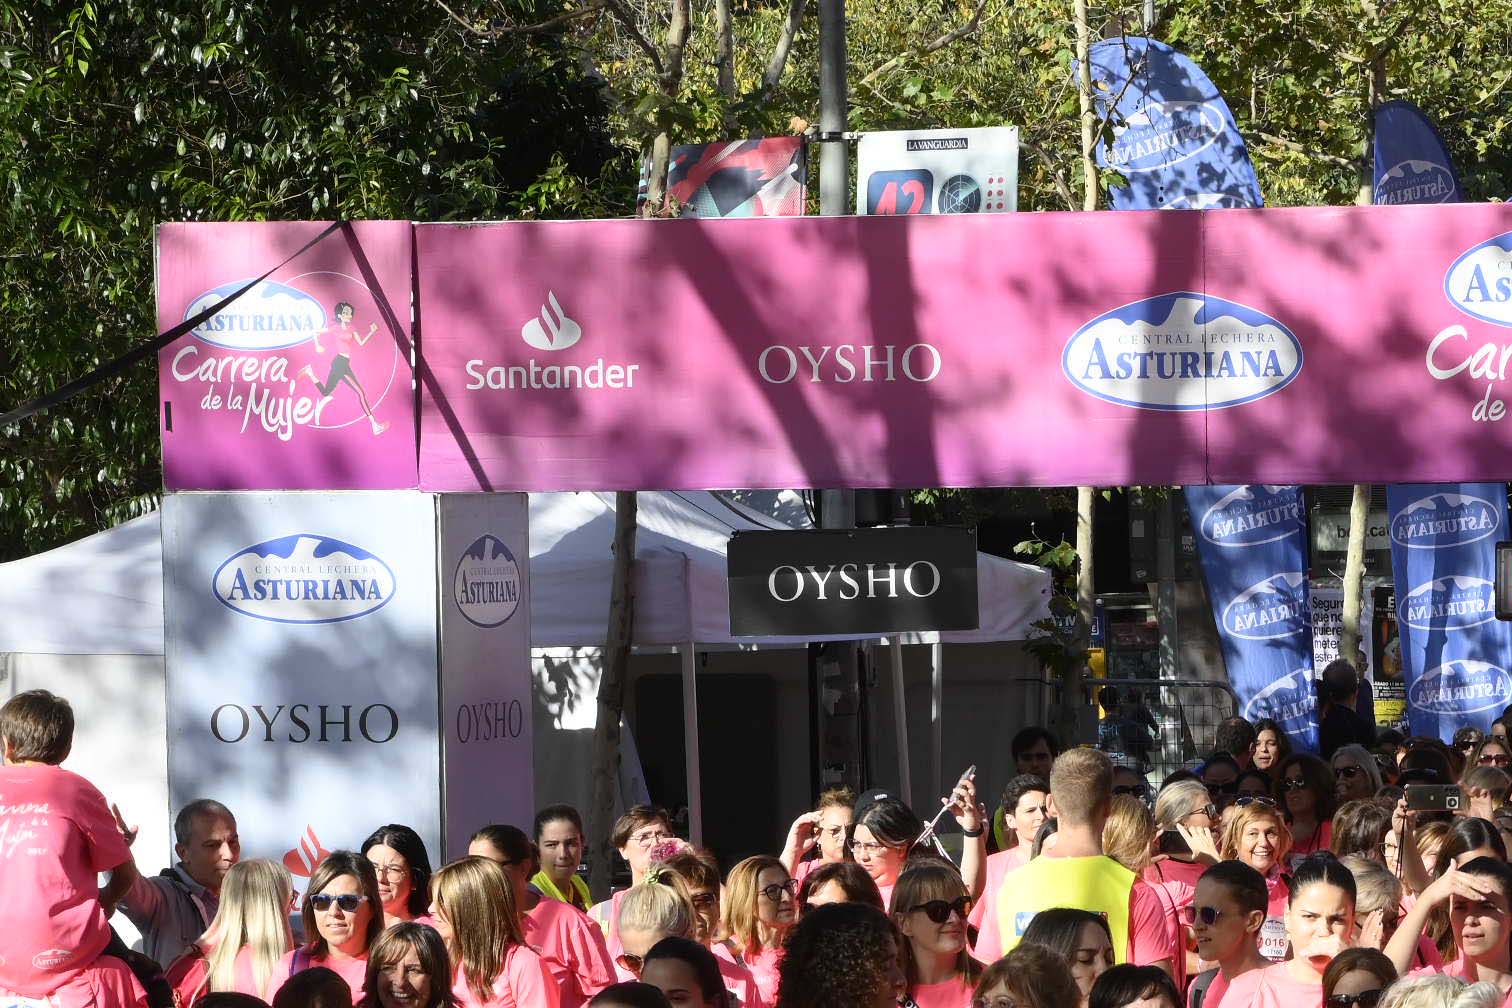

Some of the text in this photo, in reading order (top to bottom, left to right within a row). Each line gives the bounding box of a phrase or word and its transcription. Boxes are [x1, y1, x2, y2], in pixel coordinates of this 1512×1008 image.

[918, 139, 967, 150] VANGUARDIA
[1118, 332, 1276, 345] CENTRAL LECHERA
[171, 345, 289, 383] Carrera
[465, 357, 639, 391] Santander
[758, 343, 941, 384] OYSHO
[1082, 337, 1285, 381] ASTURIANA
[200, 380, 334, 441] de la Mujer
[1472, 383, 1506, 424] de
[227, 567, 382, 601] ASTURIANA
[255, 565, 376, 575] CENTRAL LECHERA
[460, 569, 517, 605] ASTURIANA
[768, 560, 941, 603] OYSHO
[210, 703, 400, 744] OYSHO
[456, 699, 523, 744] OYSHO
[1264, 938, 1285, 948] 016
